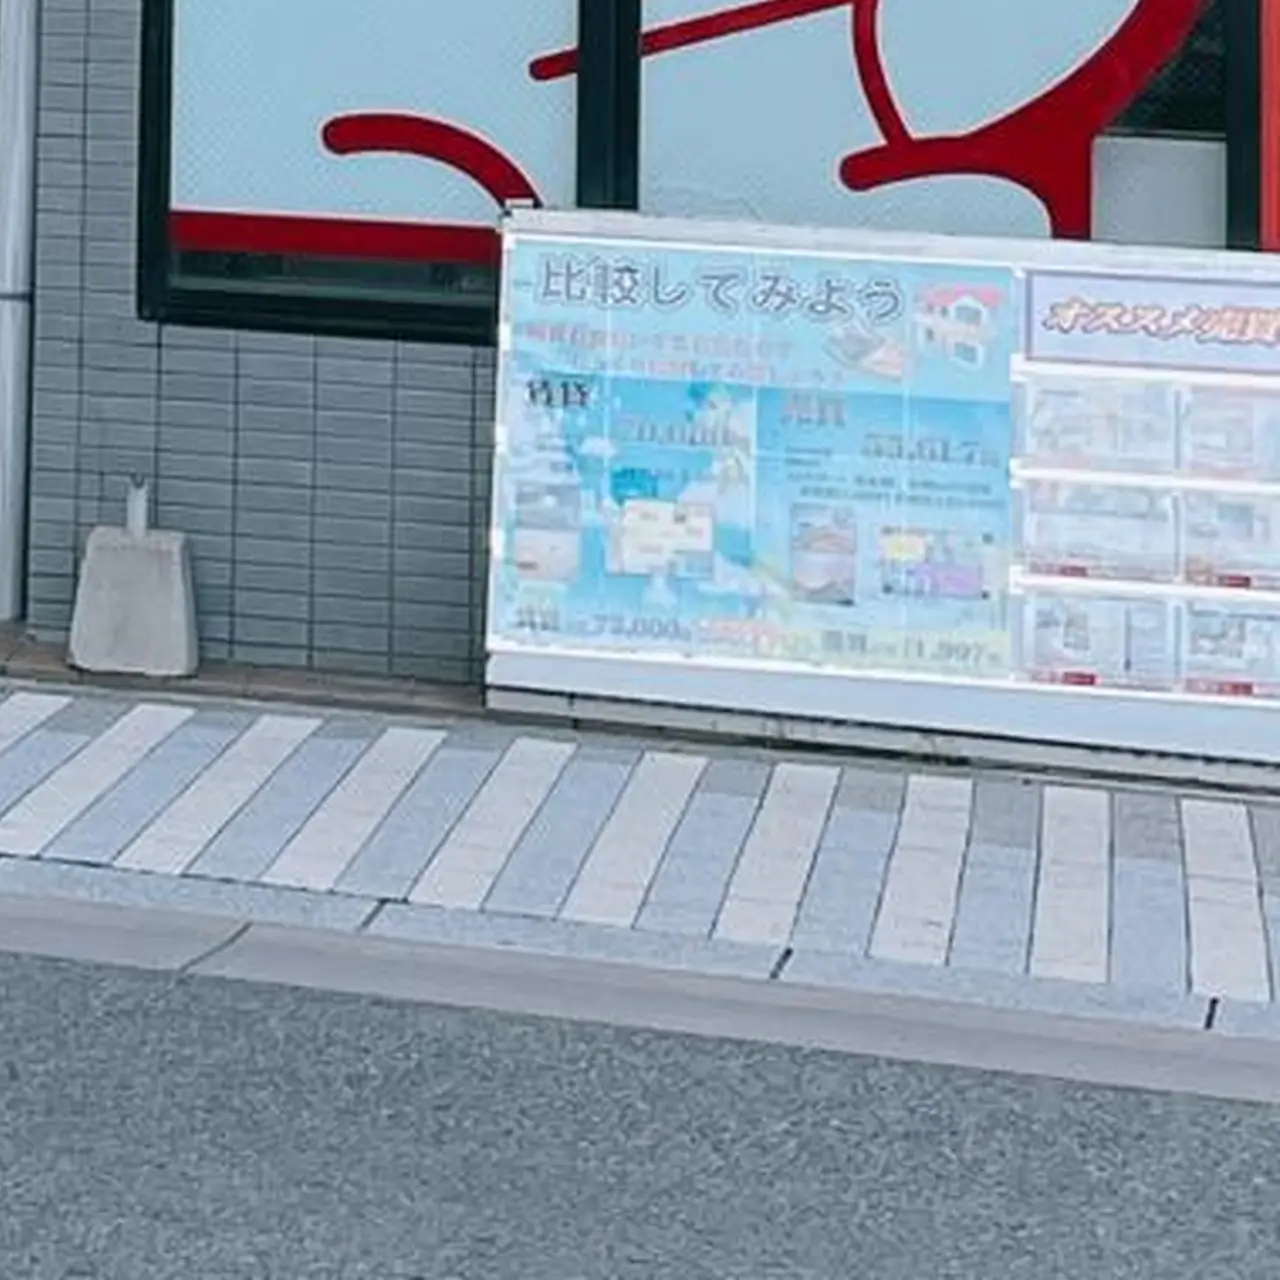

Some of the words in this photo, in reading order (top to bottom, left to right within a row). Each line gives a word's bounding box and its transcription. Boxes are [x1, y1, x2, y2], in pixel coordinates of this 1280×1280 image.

[539, 253, 906, 325] 比較してみよう
